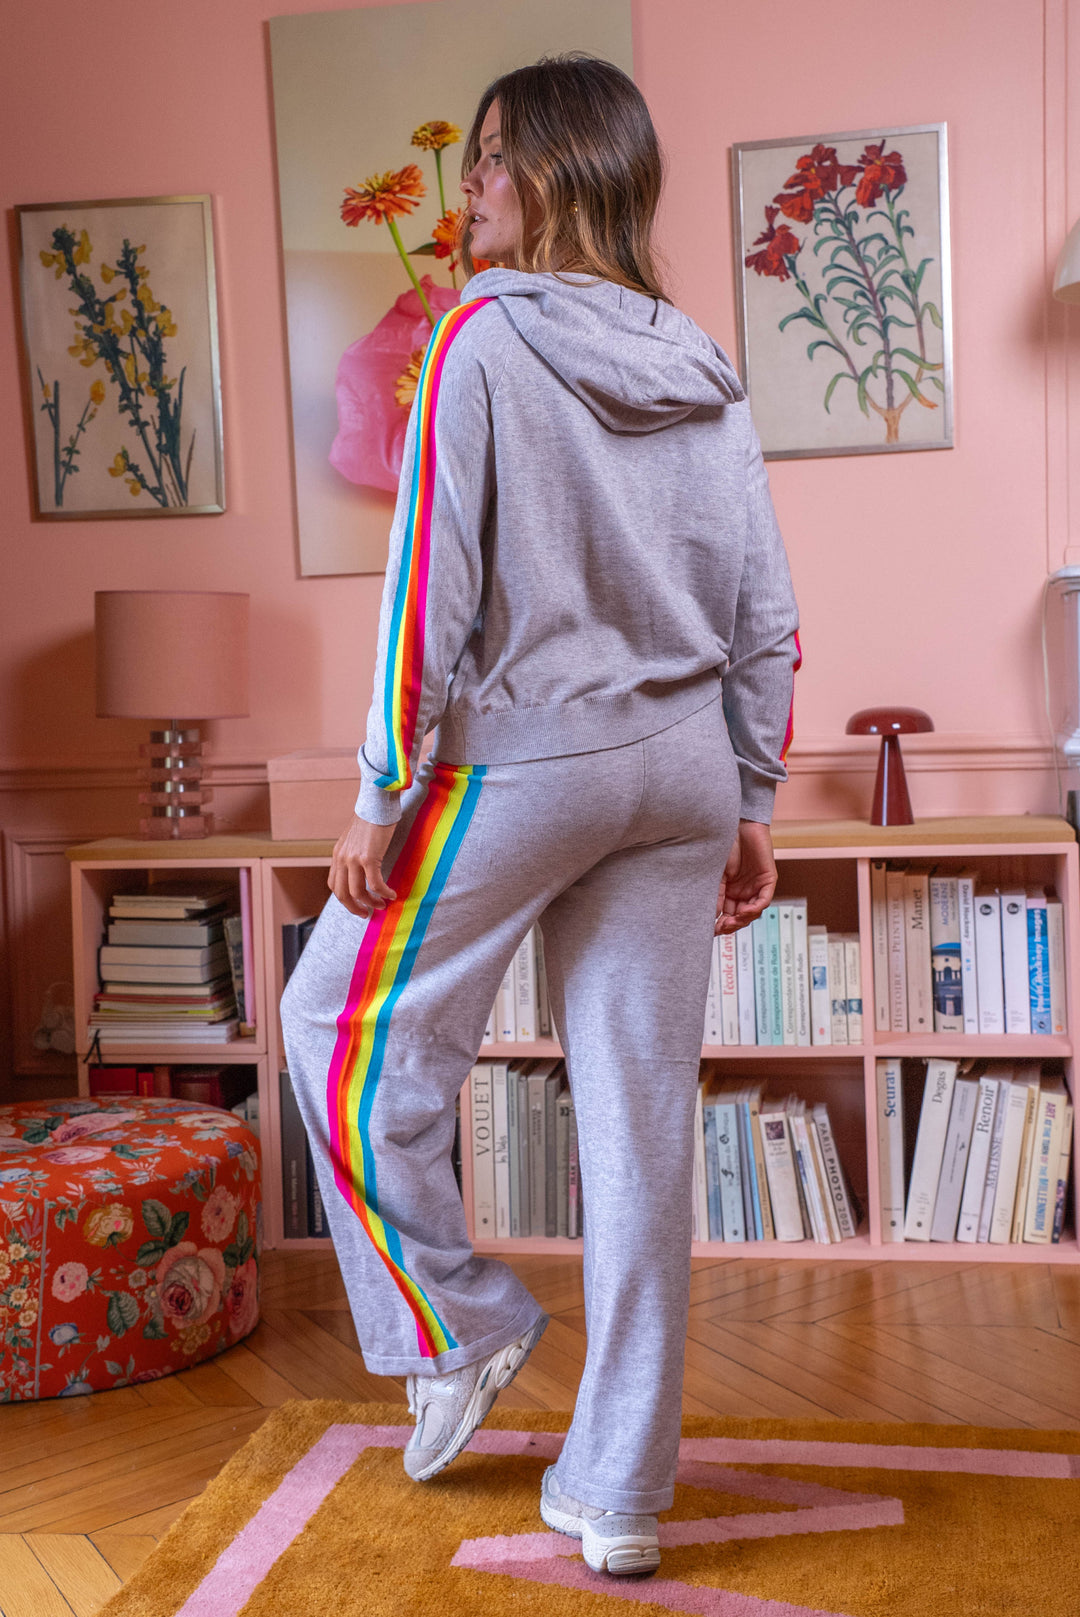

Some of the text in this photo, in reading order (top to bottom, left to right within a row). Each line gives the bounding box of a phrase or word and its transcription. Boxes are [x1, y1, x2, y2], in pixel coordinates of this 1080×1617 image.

[911, 888, 923, 930] Manet
[940, 882, 949, 926] MODERNE
[962, 884, 970, 905] David
[891, 896, 901, 953] PEINTURE
[1033, 909, 1042, 942] Images
[518, 941, 529, 1005] TEMPS MODERNES
[723, 963, 734, 995] l'école
[1034, 943, 1043, 983] Hockney
[759, 977, 767, 1034] Correspondance
[773, 978, 781, 1036] Correspondance
[786, 977, 794, 1034] Correspondance
[798, 983, 806, 1036] Correspondance
[894, 973, 903, 1028] HISTOIRE
[884, 1071, 896, 1117] Seurat
[932, 1070, 947, 1103] Degas
[976, 1085, 994, 1133] Renoir
[1045, 1102, 1056, 1119] ART
[475, 1078, 490, 1157] VOUET
[986, 1138, 1003, 1189] MATISSE
[1042, 1138, 1051, 1155] TURN
[819, 1122, 850, 1232] PARIS PHOTO 2003
[1034, 1178, 1049, 1231] MILLENNIUM
